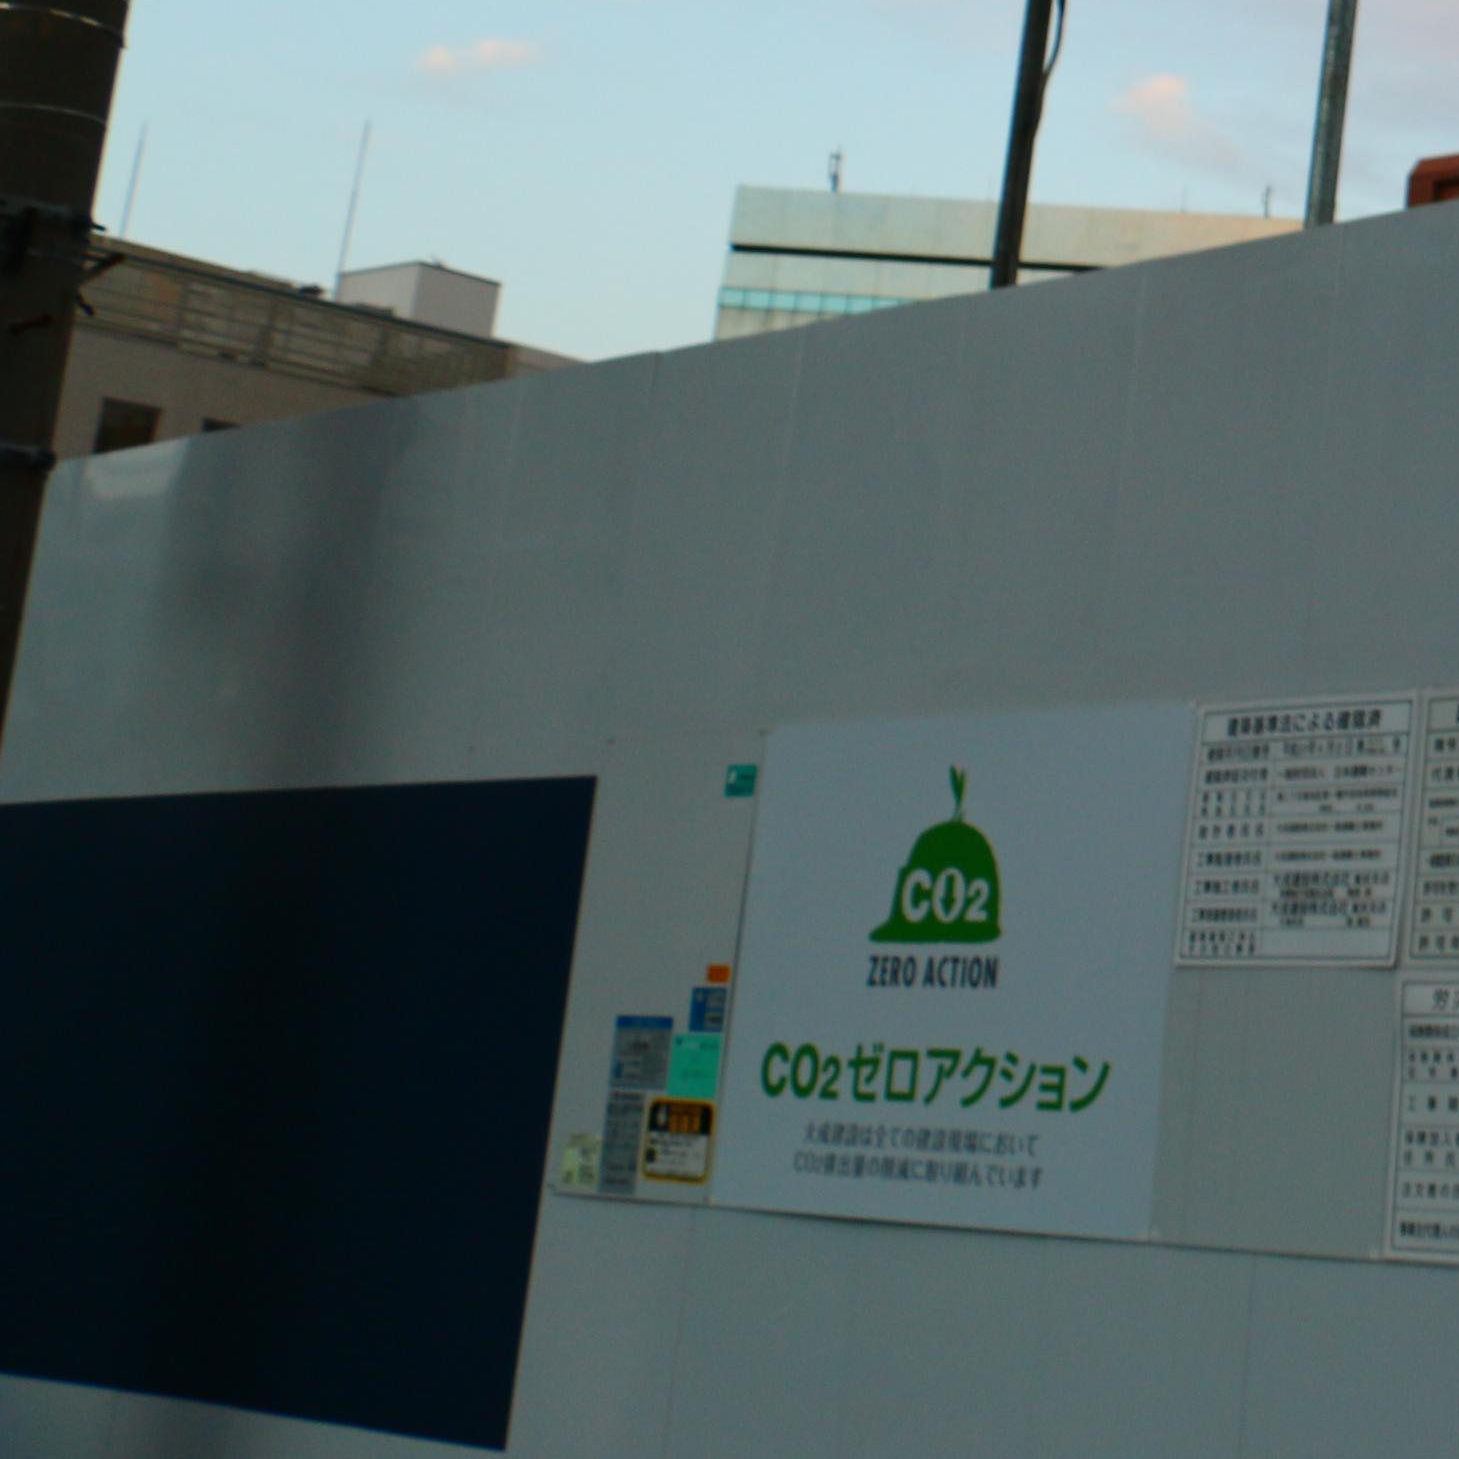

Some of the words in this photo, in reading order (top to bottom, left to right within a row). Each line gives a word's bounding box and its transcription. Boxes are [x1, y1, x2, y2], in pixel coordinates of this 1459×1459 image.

[901, 867, 990, 924] CO2
[866, 954, 916, 988] ZERO
[922, 955, 999, 989] ACTION
[760, 1042, 1111, 1112] CO2ゼロアクション
